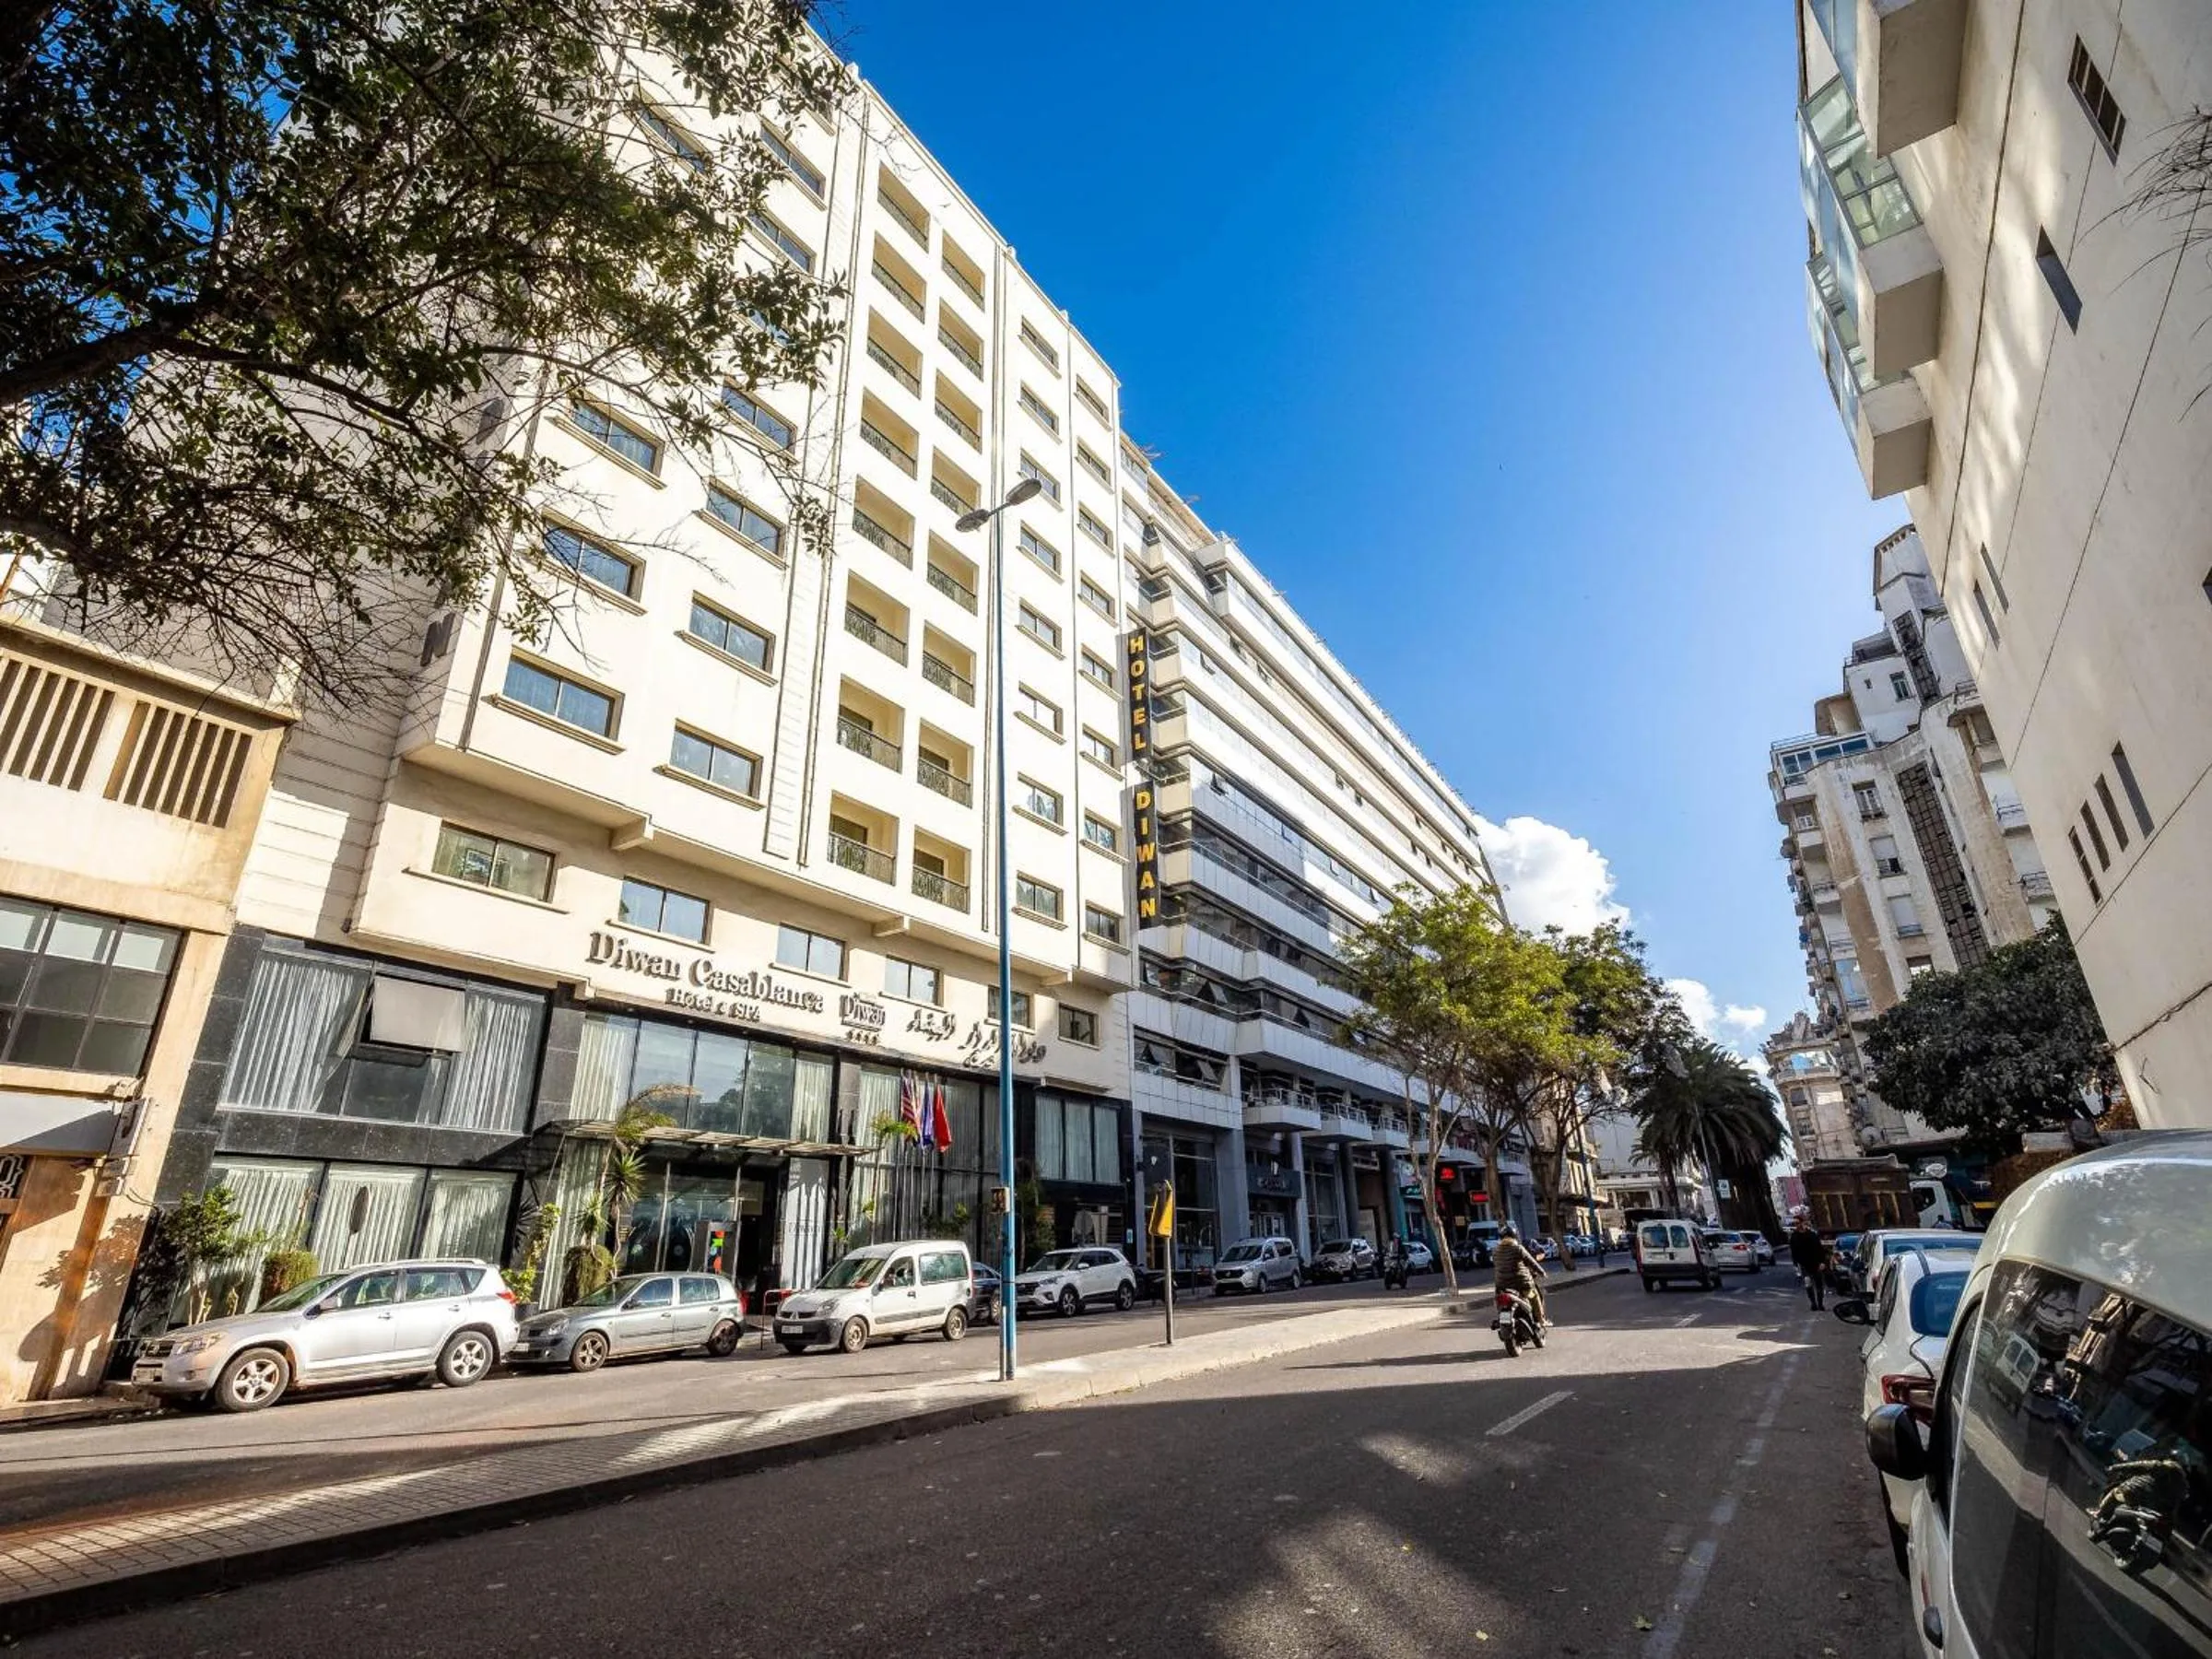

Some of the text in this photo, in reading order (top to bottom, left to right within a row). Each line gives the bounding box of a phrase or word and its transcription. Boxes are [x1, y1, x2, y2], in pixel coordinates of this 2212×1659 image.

[1129, 634, 1157, 918] HOTEL DIWAN
[585, 931, 824, 1014] Diwan Casablanca
[839, 993, 886, 1026] Diwan
